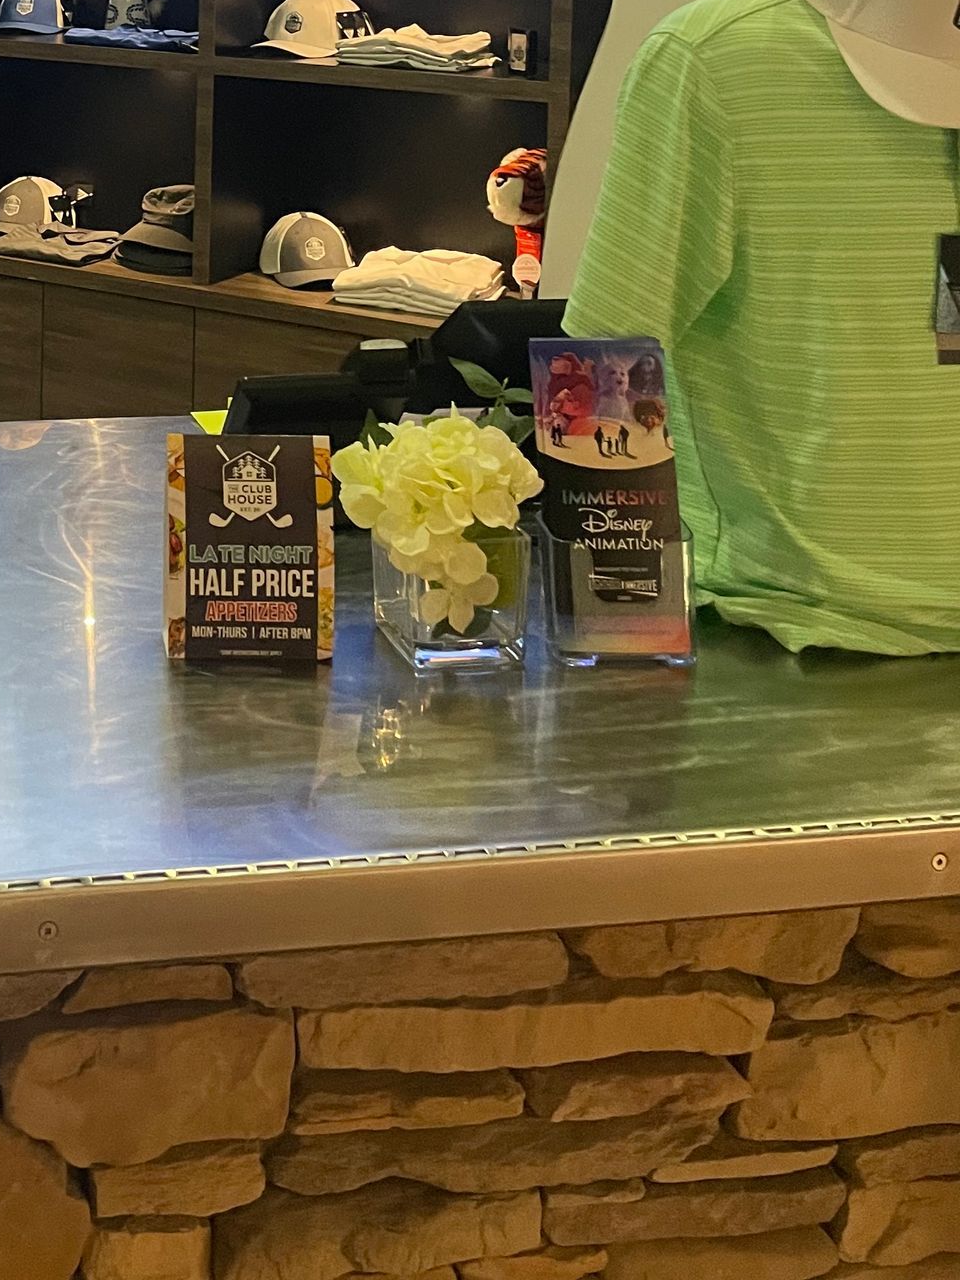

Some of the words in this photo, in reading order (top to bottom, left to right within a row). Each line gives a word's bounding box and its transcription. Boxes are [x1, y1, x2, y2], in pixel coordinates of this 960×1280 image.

[242, 484, 272, 493] CLUB
[227, 495, 272, 504] HOUSE
[562, 489, 667, 505] IMMERSIVE
[573, 538, 664, 550] ANIMATION
[189, 544, 245, 564] LATE
[248, 545, 313, 565] NIGHT
[190, 568, 246, 597] HALF
[251, 569, 315, 598] PRICE
[205, 600, 297, 623] APPETIZERS
[191, 626, 248, 639] MON-THURS
[259, 627, 288, 640] AFTER
[290, 627, 312, 640] 8PM
